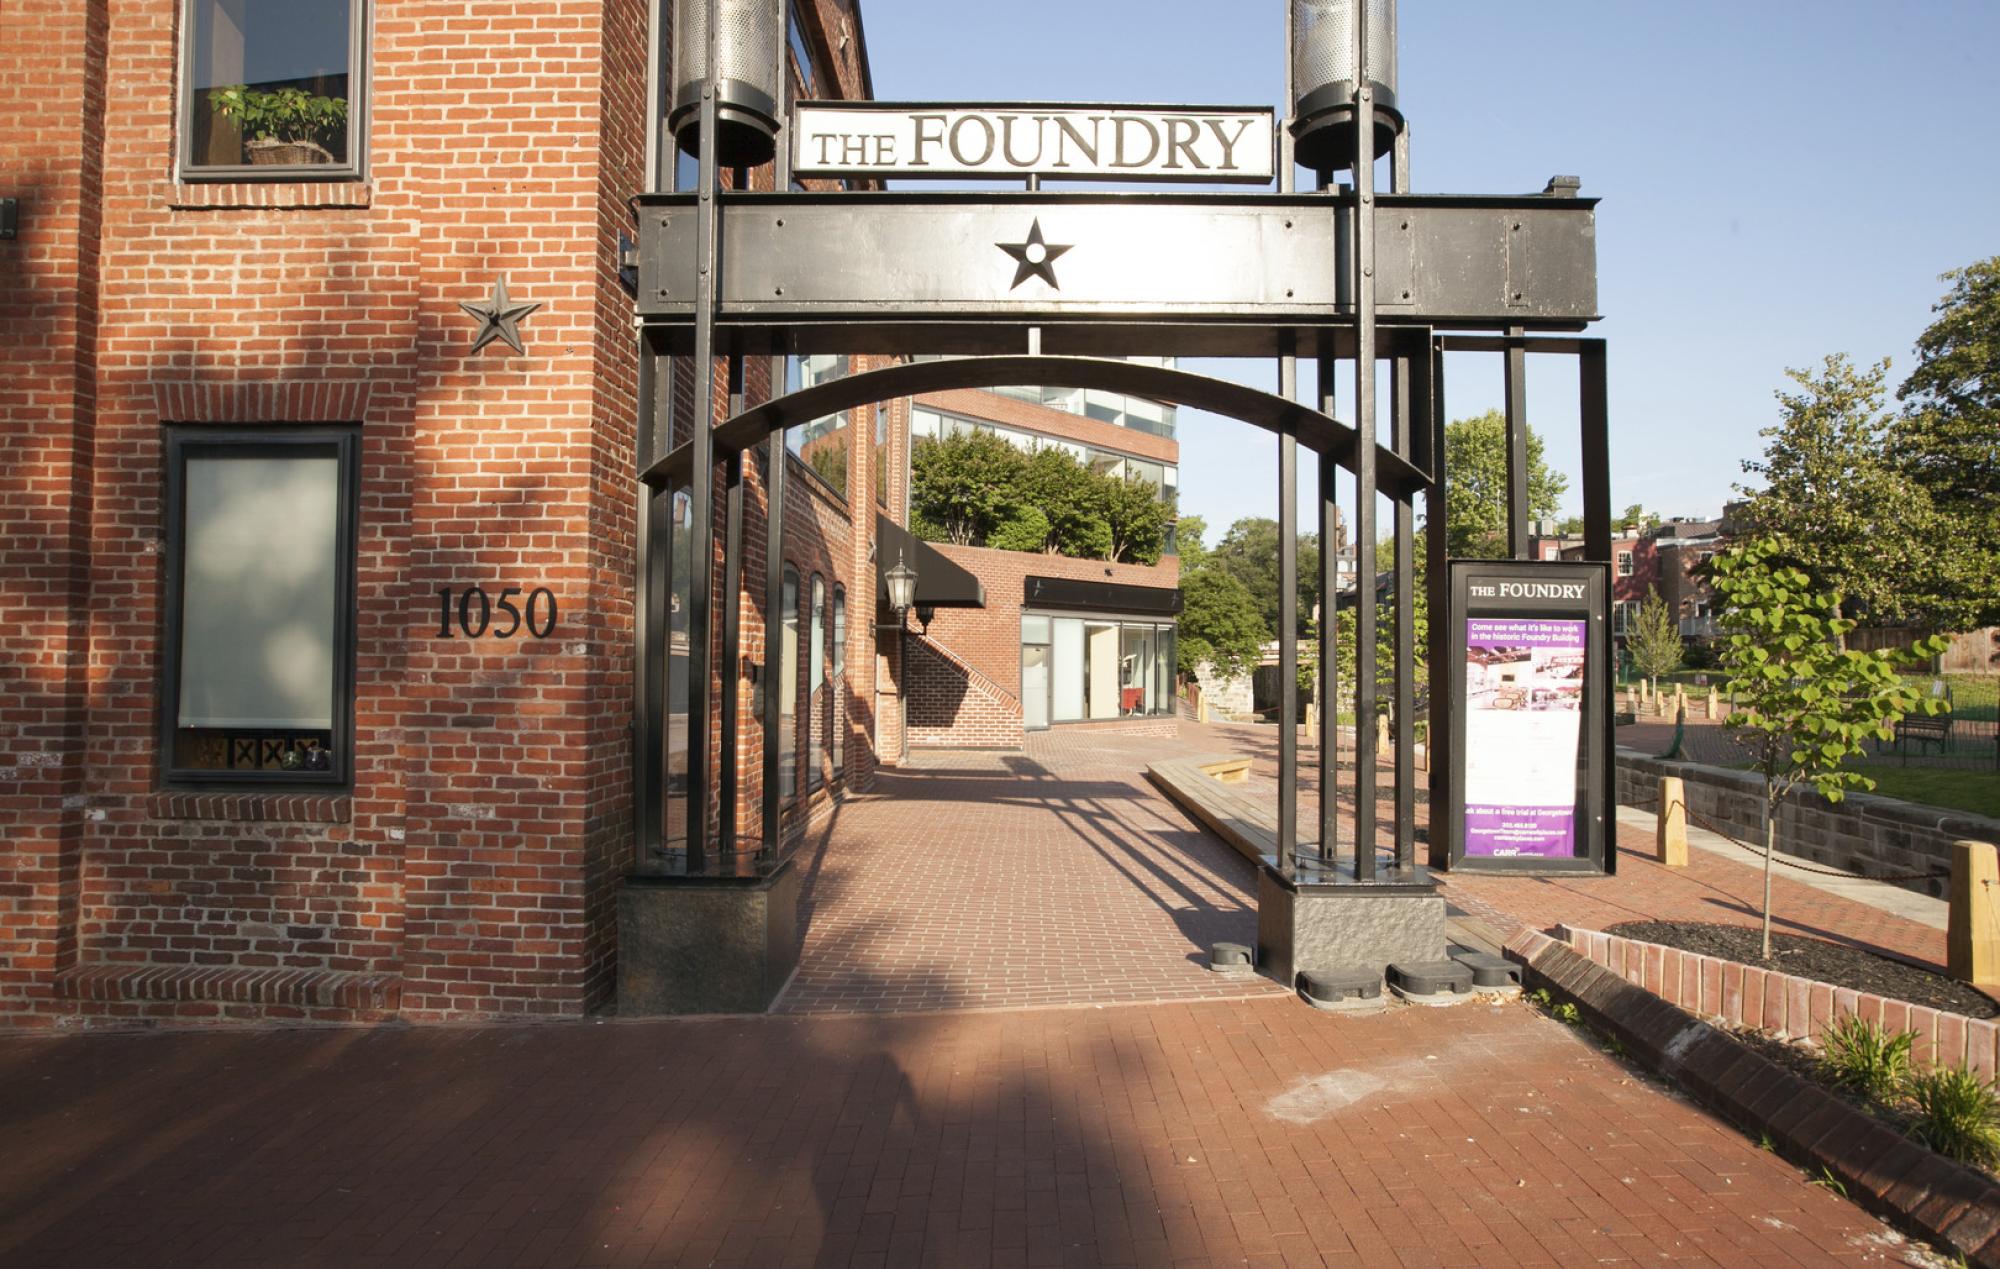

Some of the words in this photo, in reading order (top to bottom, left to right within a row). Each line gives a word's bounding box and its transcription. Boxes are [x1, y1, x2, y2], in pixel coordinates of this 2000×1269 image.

[811, 132, 898, 166] THE
[907, 113, 1255, 170] FOUNDRY
[1470, 586, 1496, 597] THE
[1499, 583, 1586, 599] FOUNDRY
[436, 587, 558, 639] 1050
[1528, 624, 1539, 632] it's
[1540, 624, 1553, 632] like
[1562, 624, 1579, 632] work
[1471, 632, 1478, 640] in
[1479, 632, 1491, 640] the
[1492, 632, 1521, 640] historic
[1521, 634, 1552, 642] Foundry
[1552, 634, 1580, 644] Building
[1501, 808, 1515, 816] free
